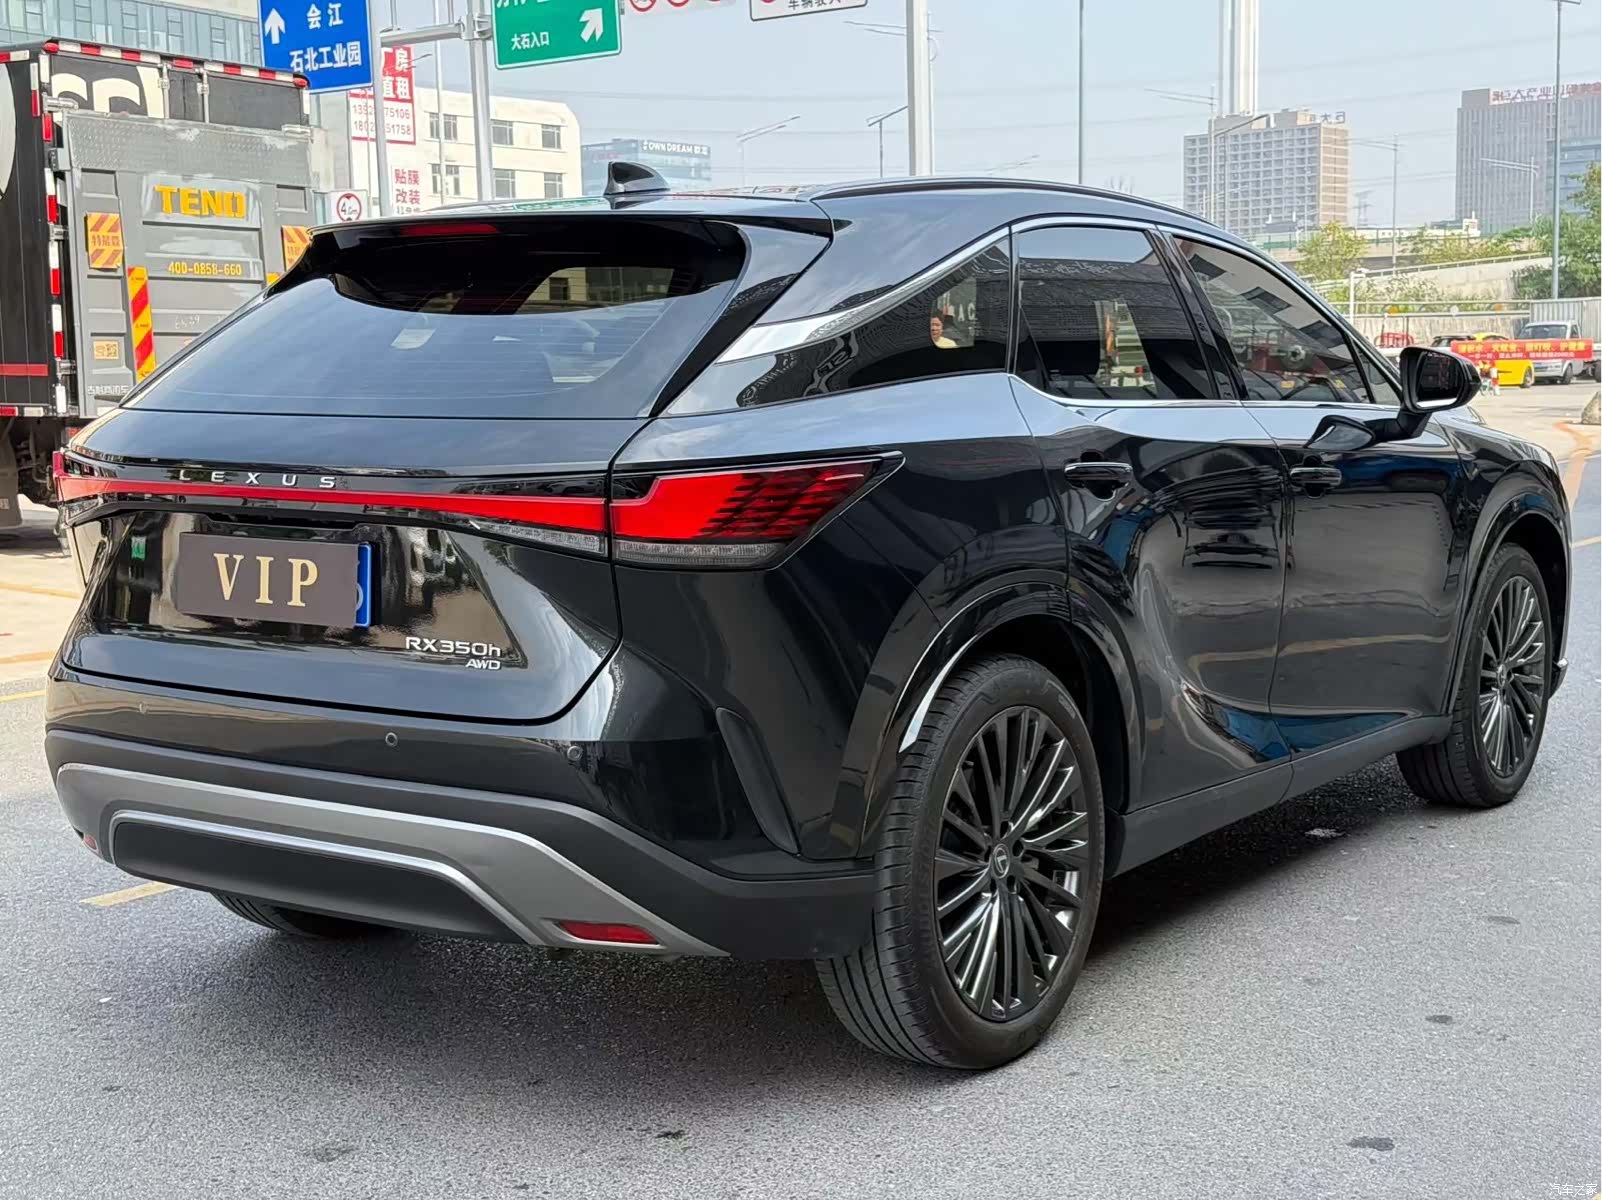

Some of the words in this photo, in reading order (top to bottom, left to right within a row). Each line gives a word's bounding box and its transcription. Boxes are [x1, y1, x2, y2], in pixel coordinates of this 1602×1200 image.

[306, 3, 344, 30] 会江
[511, 31, 550, 50] 大石入口
[289, 41, 362, 73] 石北工业园
[394, 168, 420, 185] 贴膜
[395, 188, 420, 205] 改装
[168, 261, 242, 276] 400-0858-660
[179, 469, 335, 488] LEXUS
[213, 552, 320, 608] VIP
[405, 636, 501, 657] RX350h
[465, 658, 501, 670] AWD
